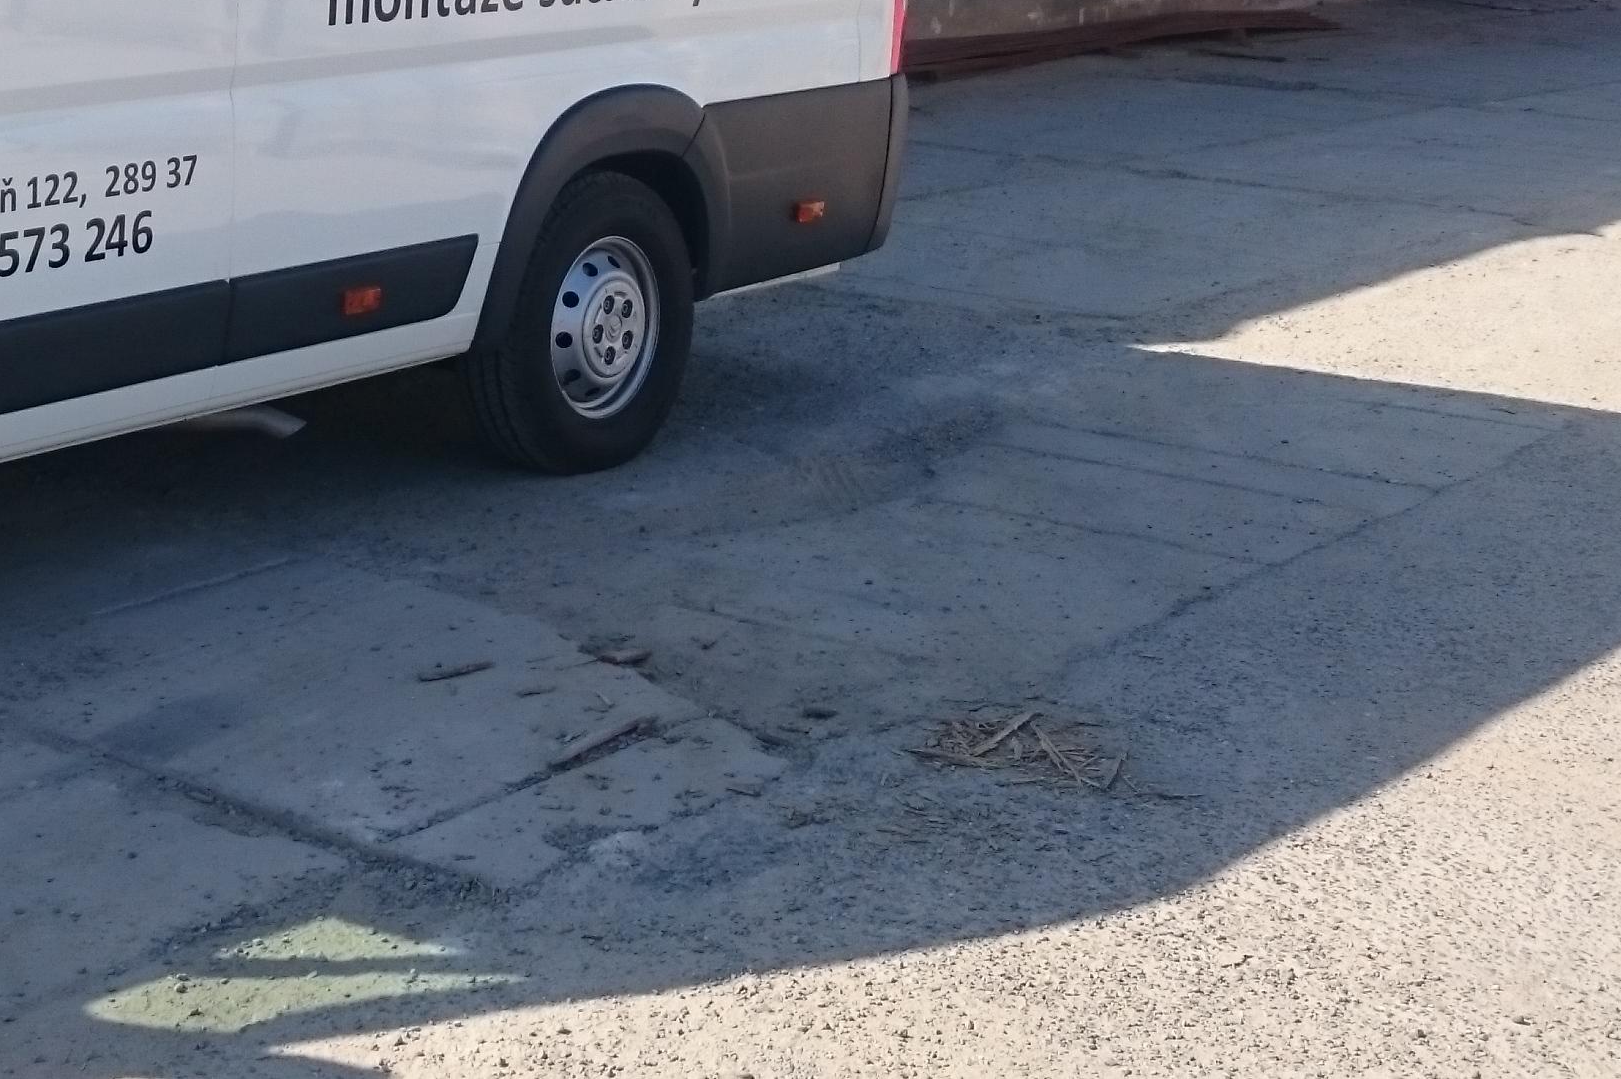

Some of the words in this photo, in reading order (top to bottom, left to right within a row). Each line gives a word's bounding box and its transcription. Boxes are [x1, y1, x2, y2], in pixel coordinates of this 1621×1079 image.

[26, 170, 87, 209] 122,
[105, 160, 157, 198] 289
[166, 154, 198, 189] 37
[85, 210, 153, 263] 246
